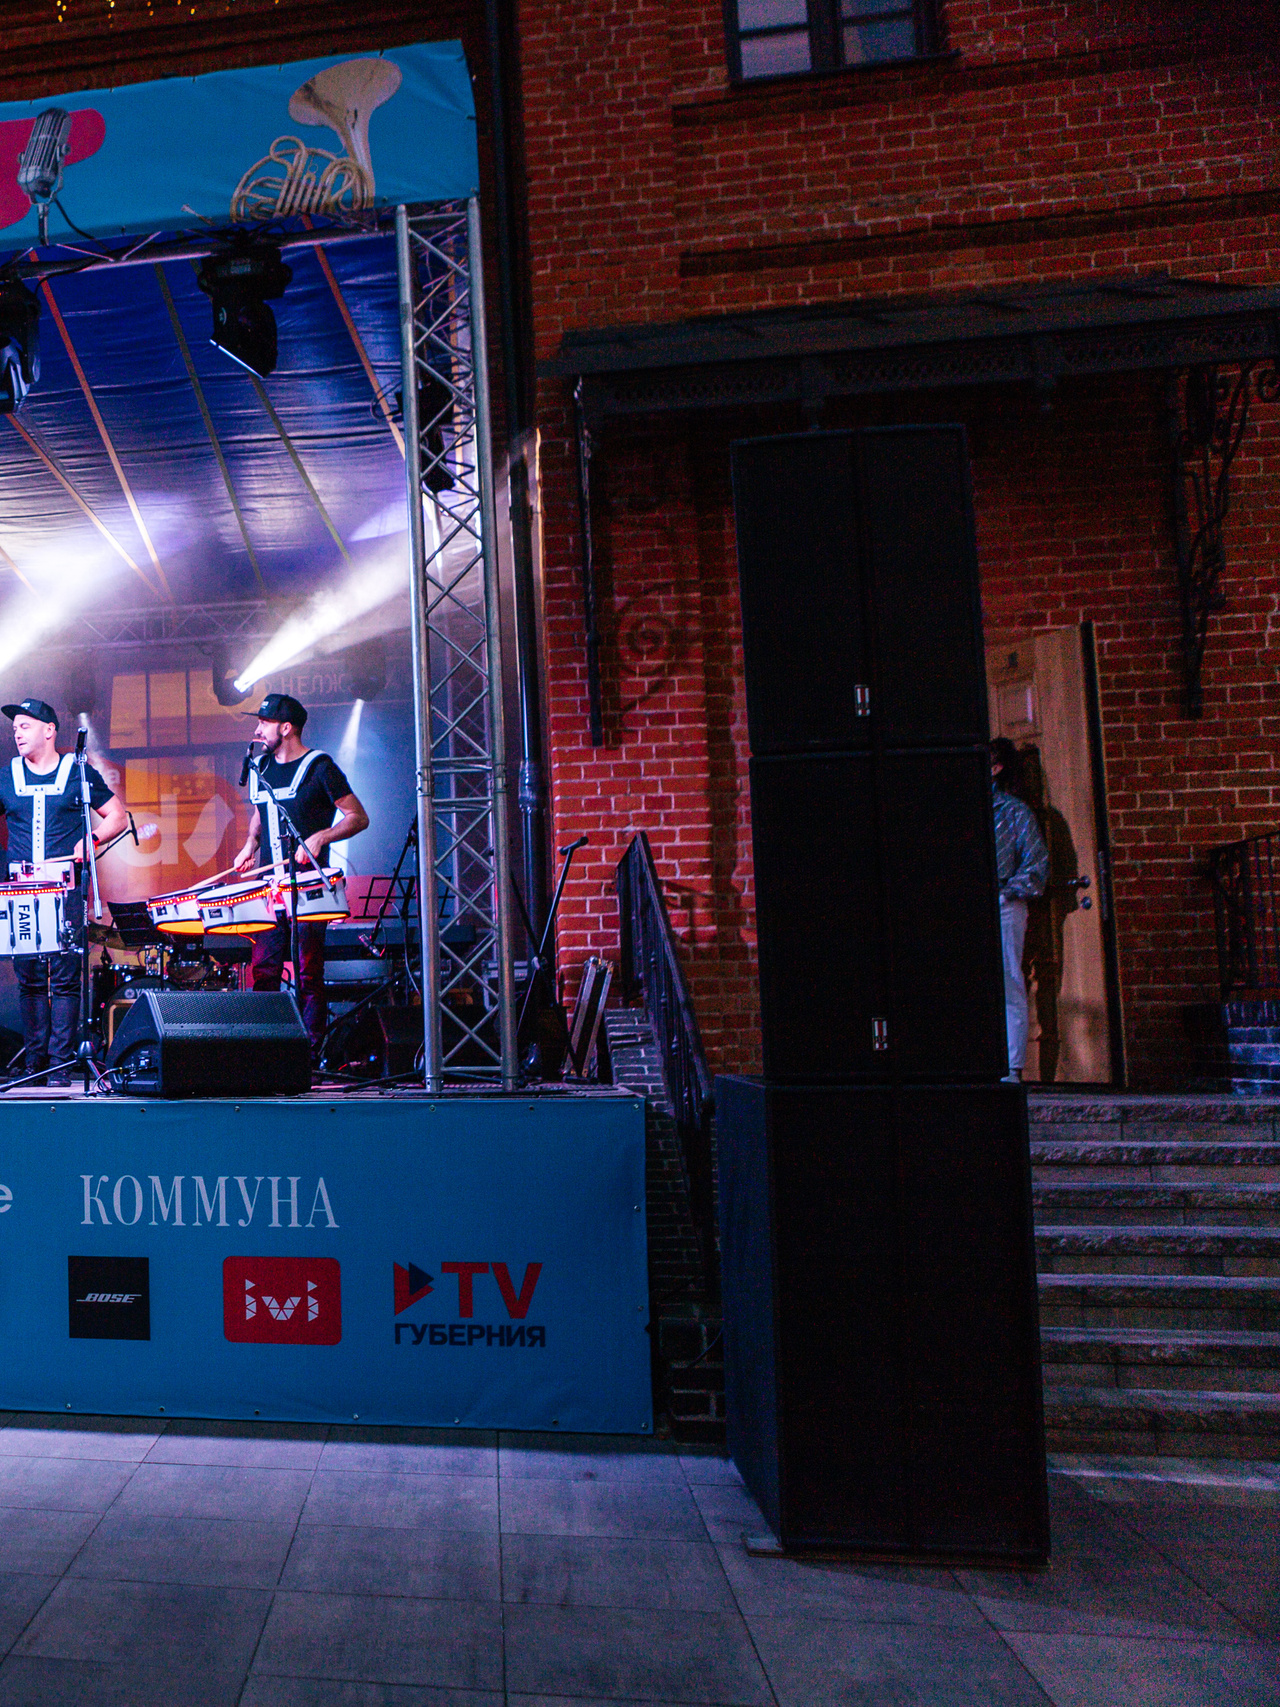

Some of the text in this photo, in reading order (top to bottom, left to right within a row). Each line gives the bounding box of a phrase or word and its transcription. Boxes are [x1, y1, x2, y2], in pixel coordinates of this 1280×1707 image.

[18, 904, 31, 941] FAME
[79, 1174, 340, 1229] КОММУНА
[76, 1293, 142, 1304] BOSE
[440, 1261, 543, 1320] TV
[394, 1323, 546, 1348] ГУБЕРНИЯ
